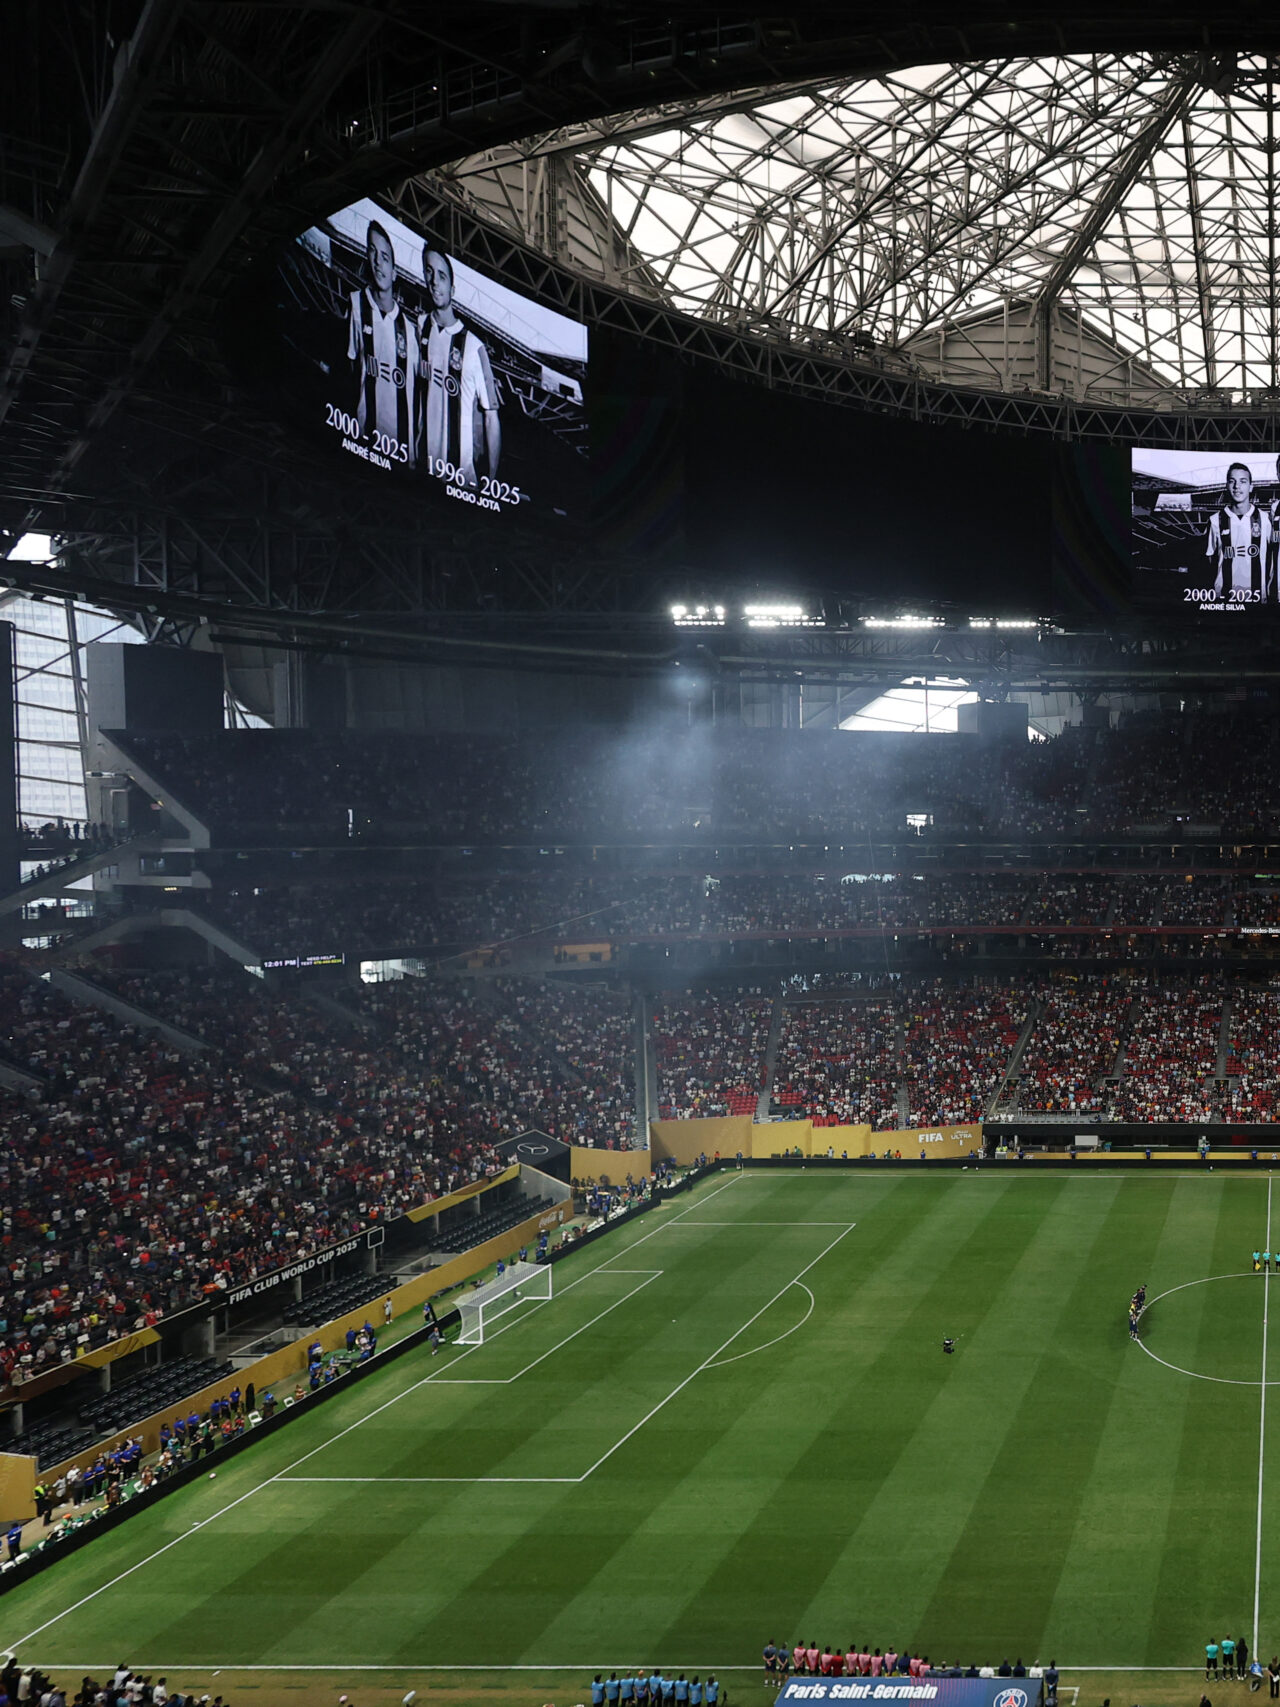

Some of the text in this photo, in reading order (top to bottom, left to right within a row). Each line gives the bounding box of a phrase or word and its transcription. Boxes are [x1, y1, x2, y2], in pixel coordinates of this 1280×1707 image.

[325, 403, 359, 440] 2000
[372, 429, 408, 463] 2025
[342, 438, 391, 471] ANDRÉ SILVA
[427, 455, 466, 487] 1996
[480, 475, 520, 505] 2025
[446, 485, 500, 512] DIOGO JOTA
[1183, 588, 1216, 602] 2000
[1228, 589, 1261, 603] 2025
[1199, 603, 1245, 612] ANDRÉ SILVA
[919, 1132, 944, 1143] FIFA
[229, 1289, 252, 1305] FIFA
[254, 1275, 280, 1293] CLUB
[281, 1259, 315, 1281] WORLD
[316, 1251, 334, 1265] CUP
[784, 1683, 938, 1699] Paris Saint-Germain
